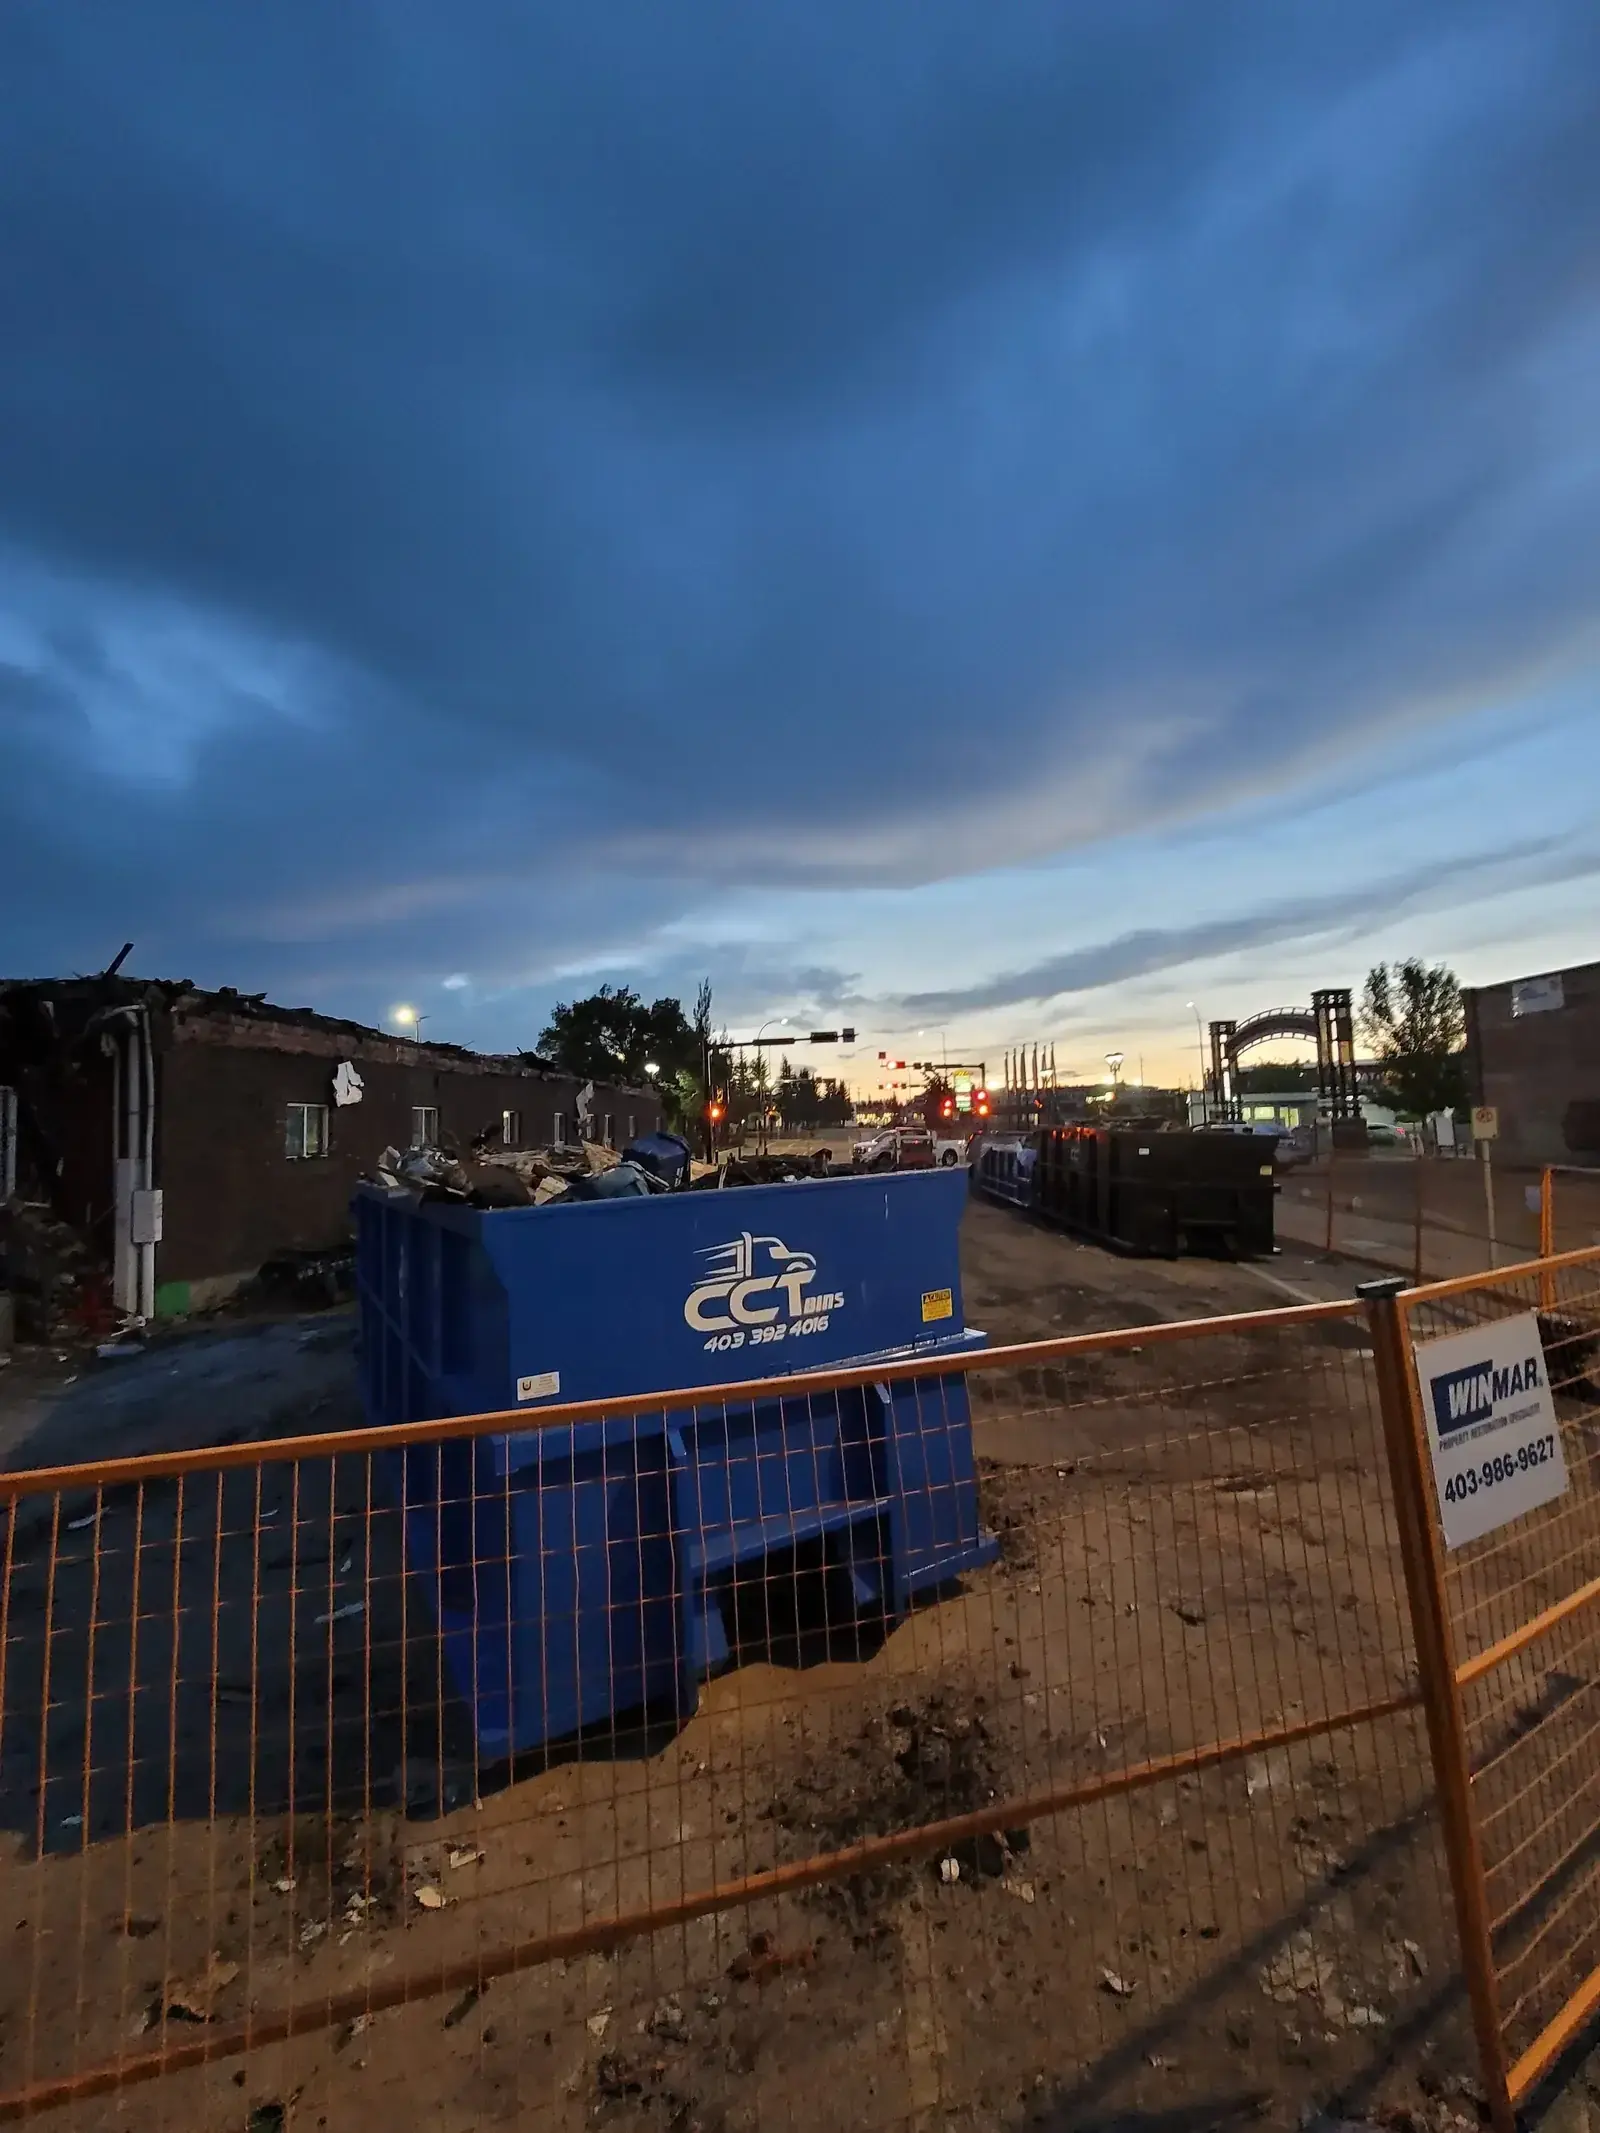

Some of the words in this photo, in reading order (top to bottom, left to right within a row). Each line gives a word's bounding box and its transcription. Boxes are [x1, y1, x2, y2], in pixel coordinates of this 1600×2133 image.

[684, 1268, 817, 1332] CCT
[703, 1331, 745, 1353] 403
[748, 1323, 787, 1346] 392
[789, 1315, 829, 1337] 4016
[1448, 1356, 1538, 1420] WINMAR
[1445, 1434, 1555, 1503] 403-986-9627
